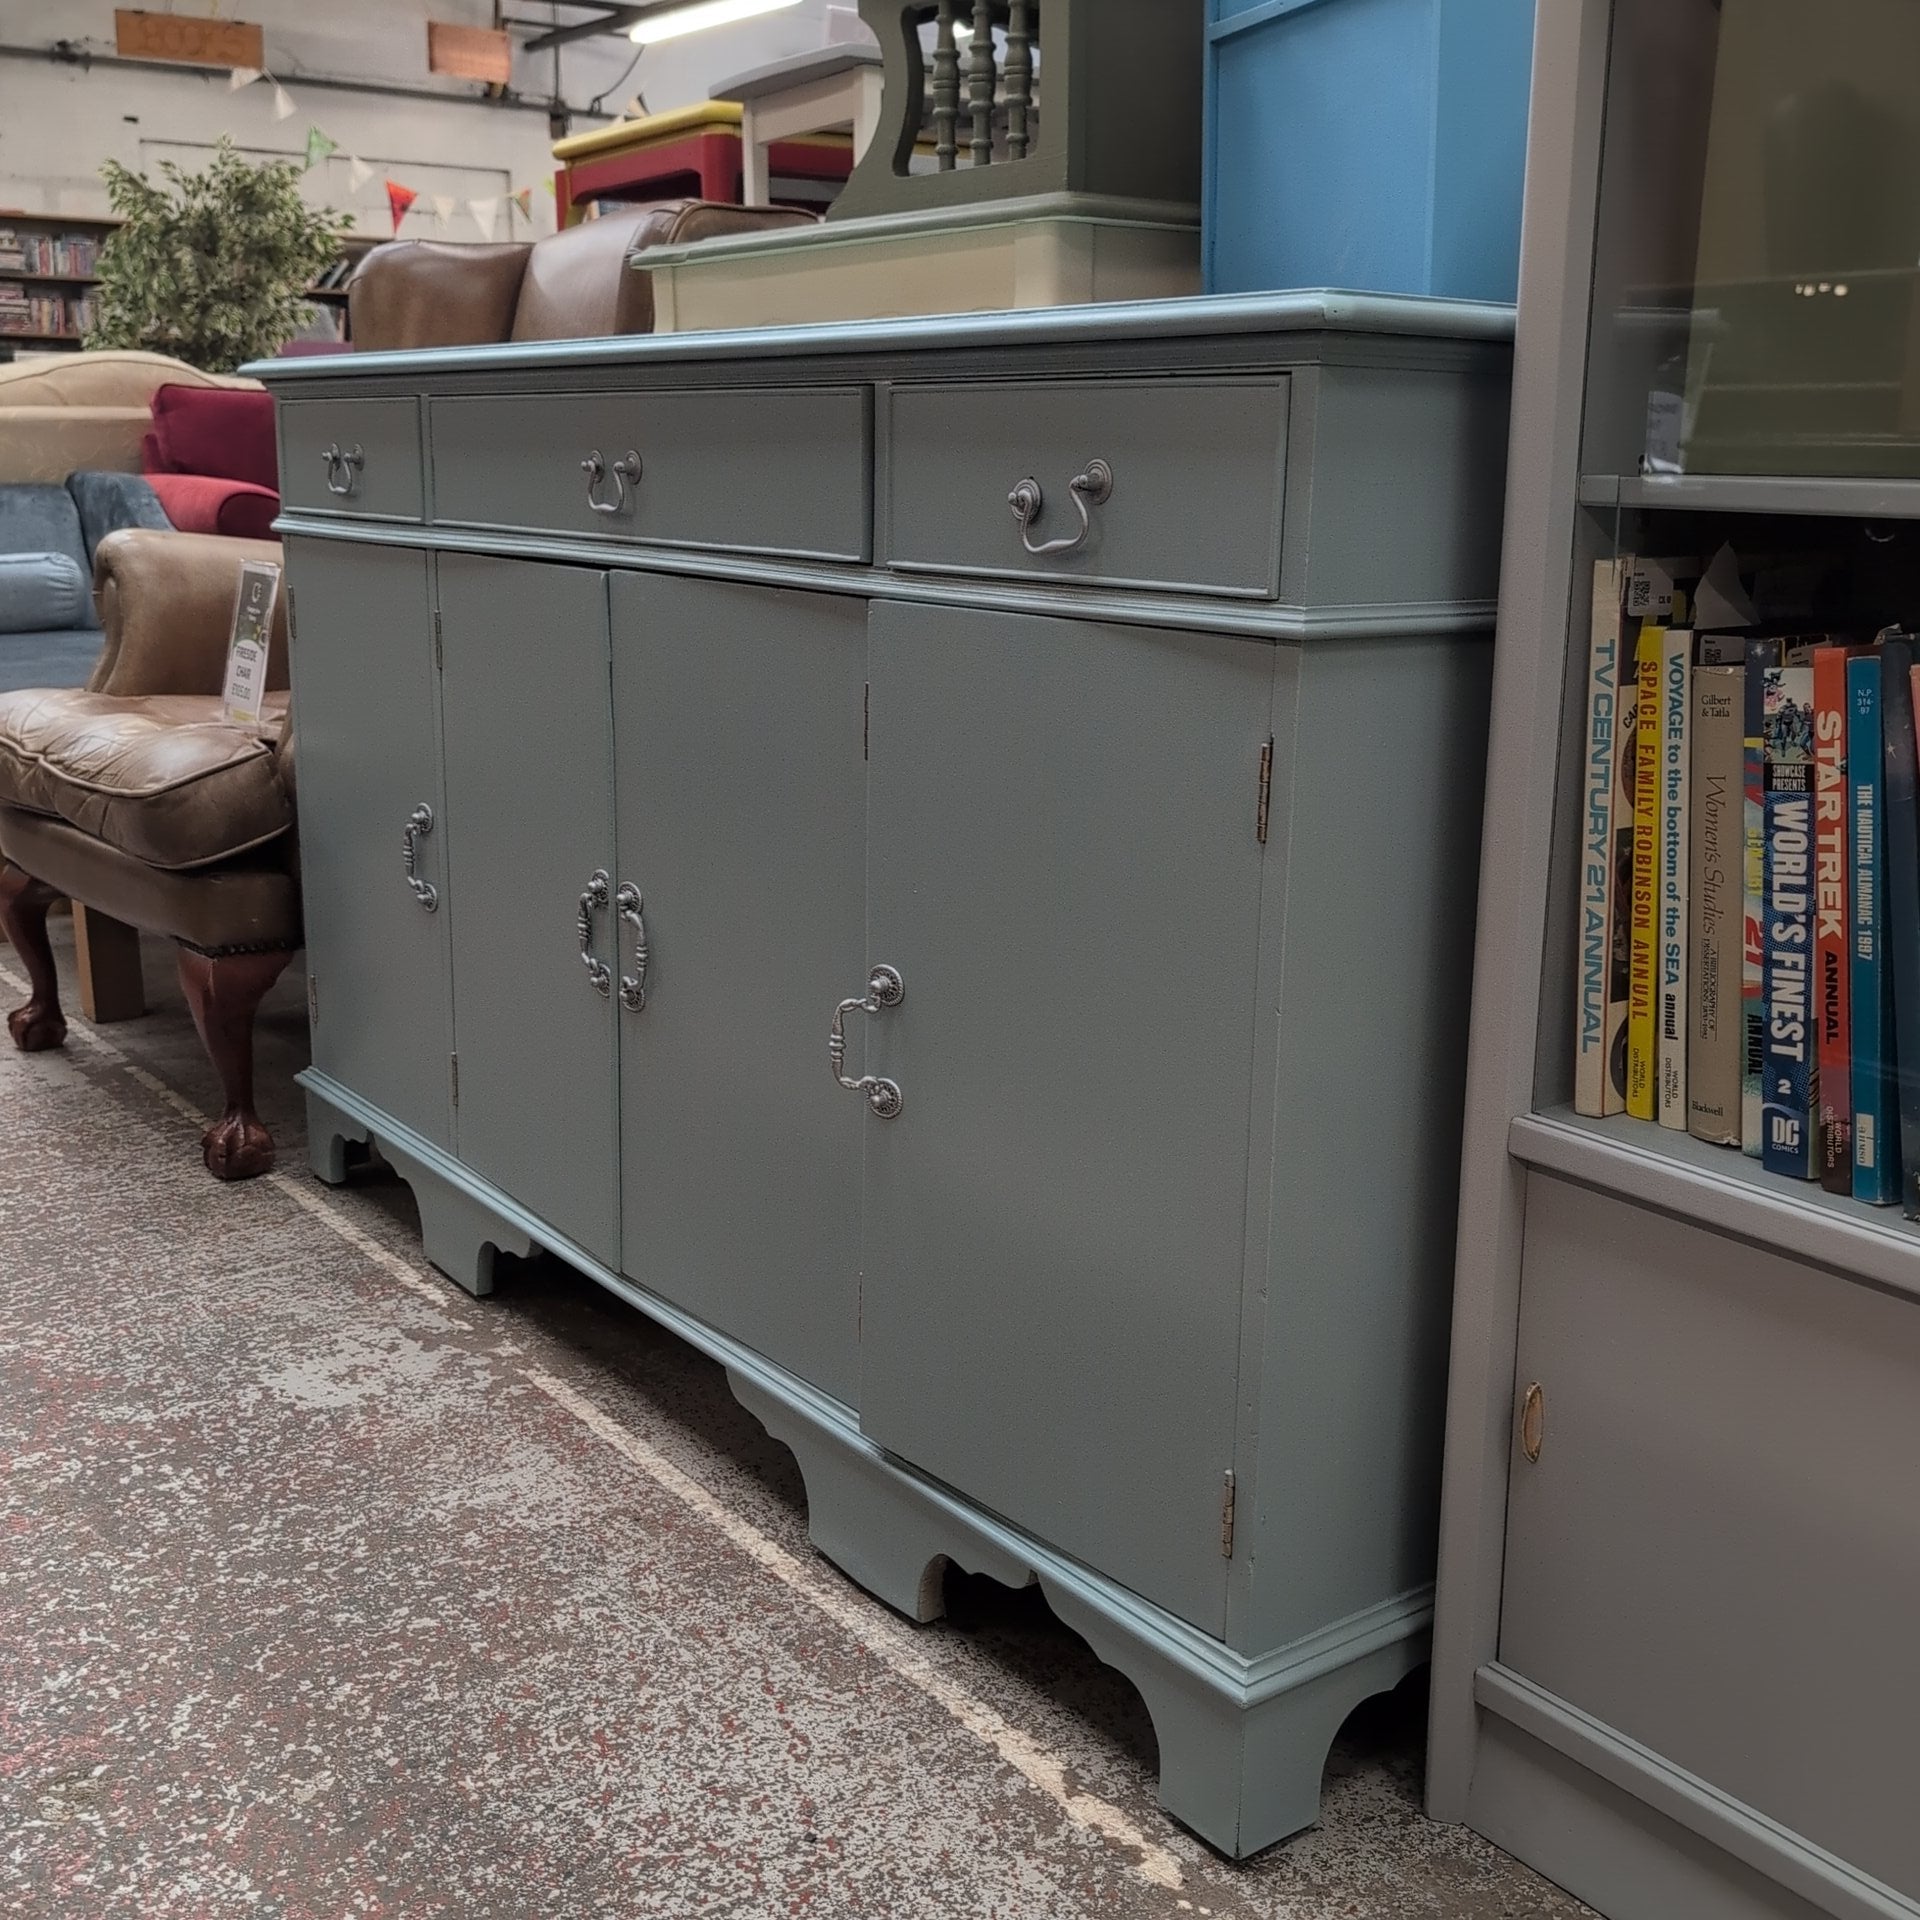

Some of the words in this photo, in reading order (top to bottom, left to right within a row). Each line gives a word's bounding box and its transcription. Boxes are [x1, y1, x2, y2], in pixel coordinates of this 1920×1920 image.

[1595, 639, 1615, 688] TV
[1640, 661, 1658, 730] SPACE
[1668, 653, 1685, 740] VOYAGE
[1701, 694, 1731, 705] Gilbert
[1588, 692, 1613, 860] CENTURY
[1637, 745, 1656, 817] FAMILY
[1667, 743, 1679, 762] to
[1772, 764, 1806, 778] SHOWCASE
[1816, 711, 1842, 821] STAR
[1667, 767, 1681, 800] the
[1772, 778, 1806, 791] PRESENTS
[1857, 784, 1873, 805] THE
[1666, 806, 1682, 877] bottom
[1705, 774, 1726, 864] Women's
[1857, 809, 1873, 866] NAUTICAL
[1586, 864, 1606, 902] 21
[1634, 825, 1653, 929] ROBINSON
[1666, 882, 1681, 902] of
[1771, 800, 1808, 943] WORLD'S
[1816, 827, 1843, 940] TREK
[1857, 868, 1873, 925] ALMANAC
[1666, 907, 1680, 938] the
[1703, 867, 1724, 935] Studies
[1665, 943, 1680, 985] SEA
[1745, 915, 1763, 967] 21
[1582, 907, 1605, 1053] ANNUAL
[1632, 939, 1650, 1020] ANNUAL
[1769, 950, 1806, 1062] FINEST
[1825, 950, 1839, 1045] ANNUAL
[1665, 993, 1678, 1041] annual
[1747, 1013, 1763, 1076] ANNUAL
[1632, 1048, 1640, 1098] DISTRIBUTORS
[1777, 1079, 1791, 1095] 2
[1772, 1116, 1800, 1146] DC
[1772, 1143, 1799, 1154] COMICS
[1826, 1106, 1835, 1168] DISTRIBUTORS
[1834, 1121, 1842, 1154] WORLD
